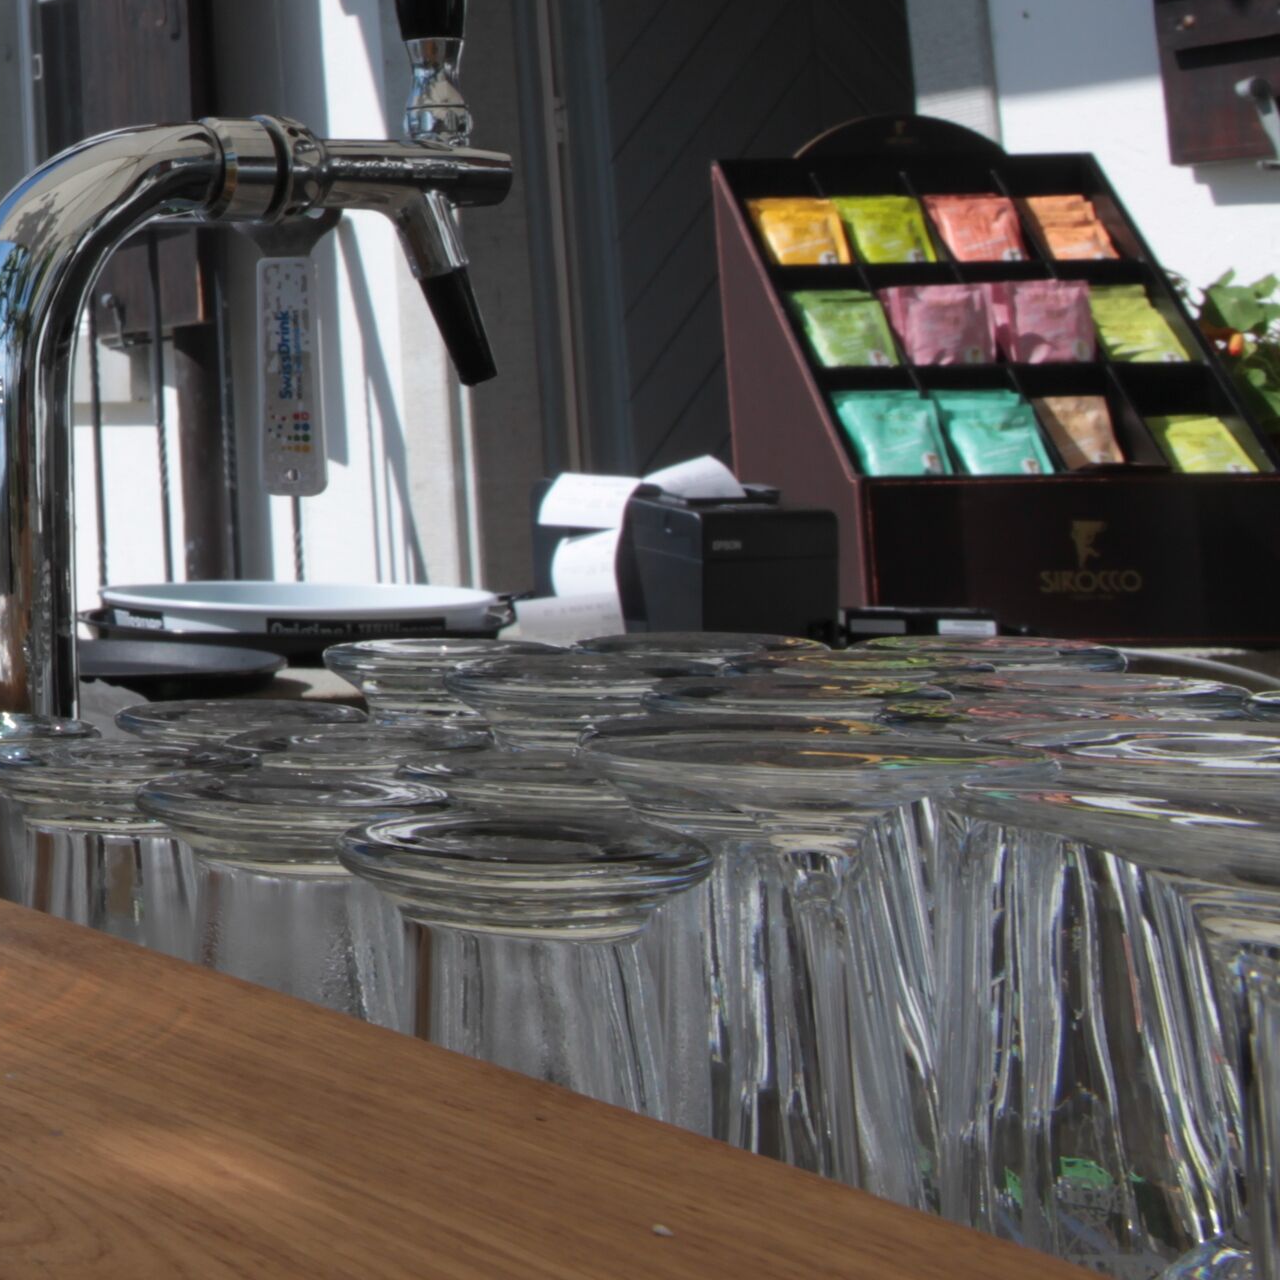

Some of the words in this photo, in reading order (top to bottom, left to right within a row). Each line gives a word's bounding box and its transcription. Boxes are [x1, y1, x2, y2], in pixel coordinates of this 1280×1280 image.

[275, 310, 293, 400] SwissDrink
[712, 539, 742, 551] EPSON
[1039, 570, 1142, 593] SIROCCO
